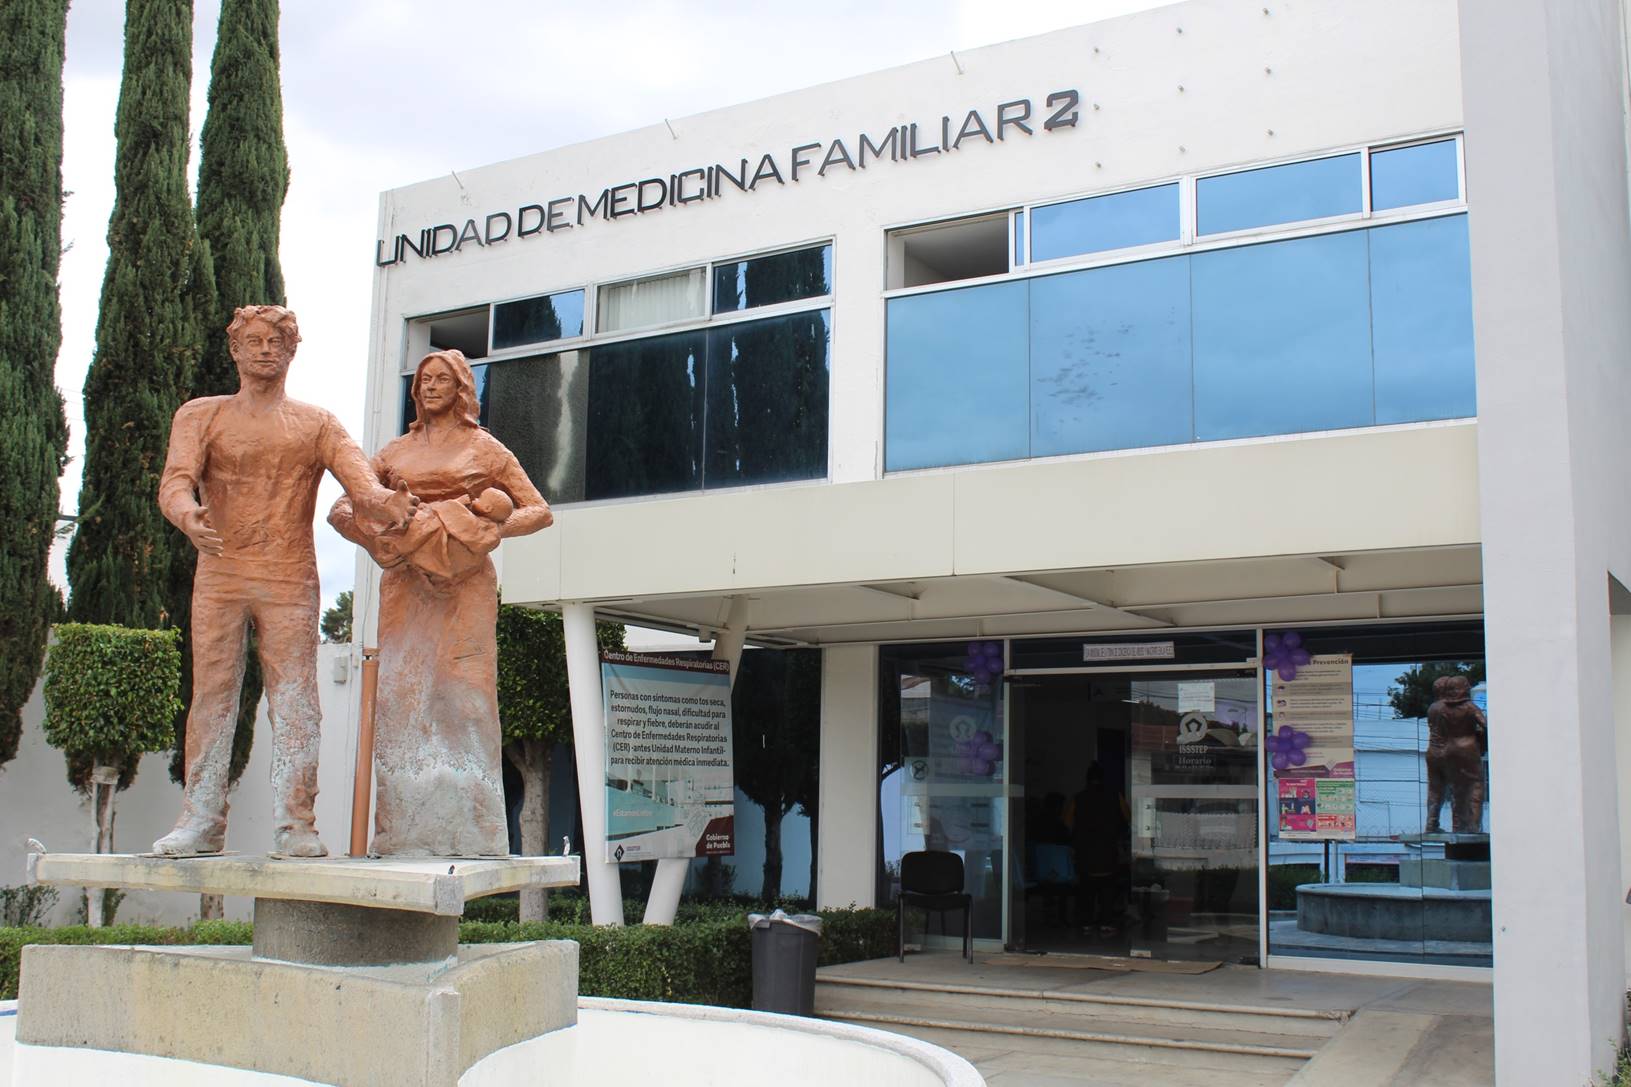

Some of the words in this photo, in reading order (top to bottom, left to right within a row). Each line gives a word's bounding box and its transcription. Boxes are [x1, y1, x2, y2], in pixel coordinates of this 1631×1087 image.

[376, 211, 512, 268] UNIDAD
[518, 196, 574, 239] DE
[577, 153, 785, 227] MEDICINA
[791, 98, 1034, 182] FAMILIAR
[1043, 89, 1079, 131] 2
[626, 653, 633, 662] de
[634, 653, 675, 666] Enfermedades
[610, 690, 639, 701] Personas
[640, 693, 652, 701] con
[682, 696, 698, 705] como
[699, 697, 708, 706] tos
[709, 698, 726, 707] seca,
[611, 704, 647, 715] estornudos,
[648, 704, 662, 717] flujo
[663, 706, 681, 717] nasal,
[682, 707, 711, 718] dificultad
[711, 710, 726, 720] para
[617, 717, 641, 728] respirar
[642, 720, 647, 729] y
[647, 717, 667, 729] fiebre,
[667, 718, 693, 729] deberán
[693, 720, 713, 730] acudir
[714, 721, 720, 731] al
[611, 729, 632, 738] Centro
[633, 730, 641, 739] de
[641, 731, 685, 741] Enfermedades
[686, 732, 728, 744] Respiratorias
[613, 742, 631, 753] (CER)
[651, 743, 674, 753] Unidad
[674, 744, 700, 754] Materno
[1179, 744, 1209, 754] ISSSTEP
[611, 757, 625, 766] para
[625, 755, 645, 765] recibir
[646, 755, 673, 766] atención
[673, 756, 696, 766] médica
[696, 757, 730, 767] inmediata.
